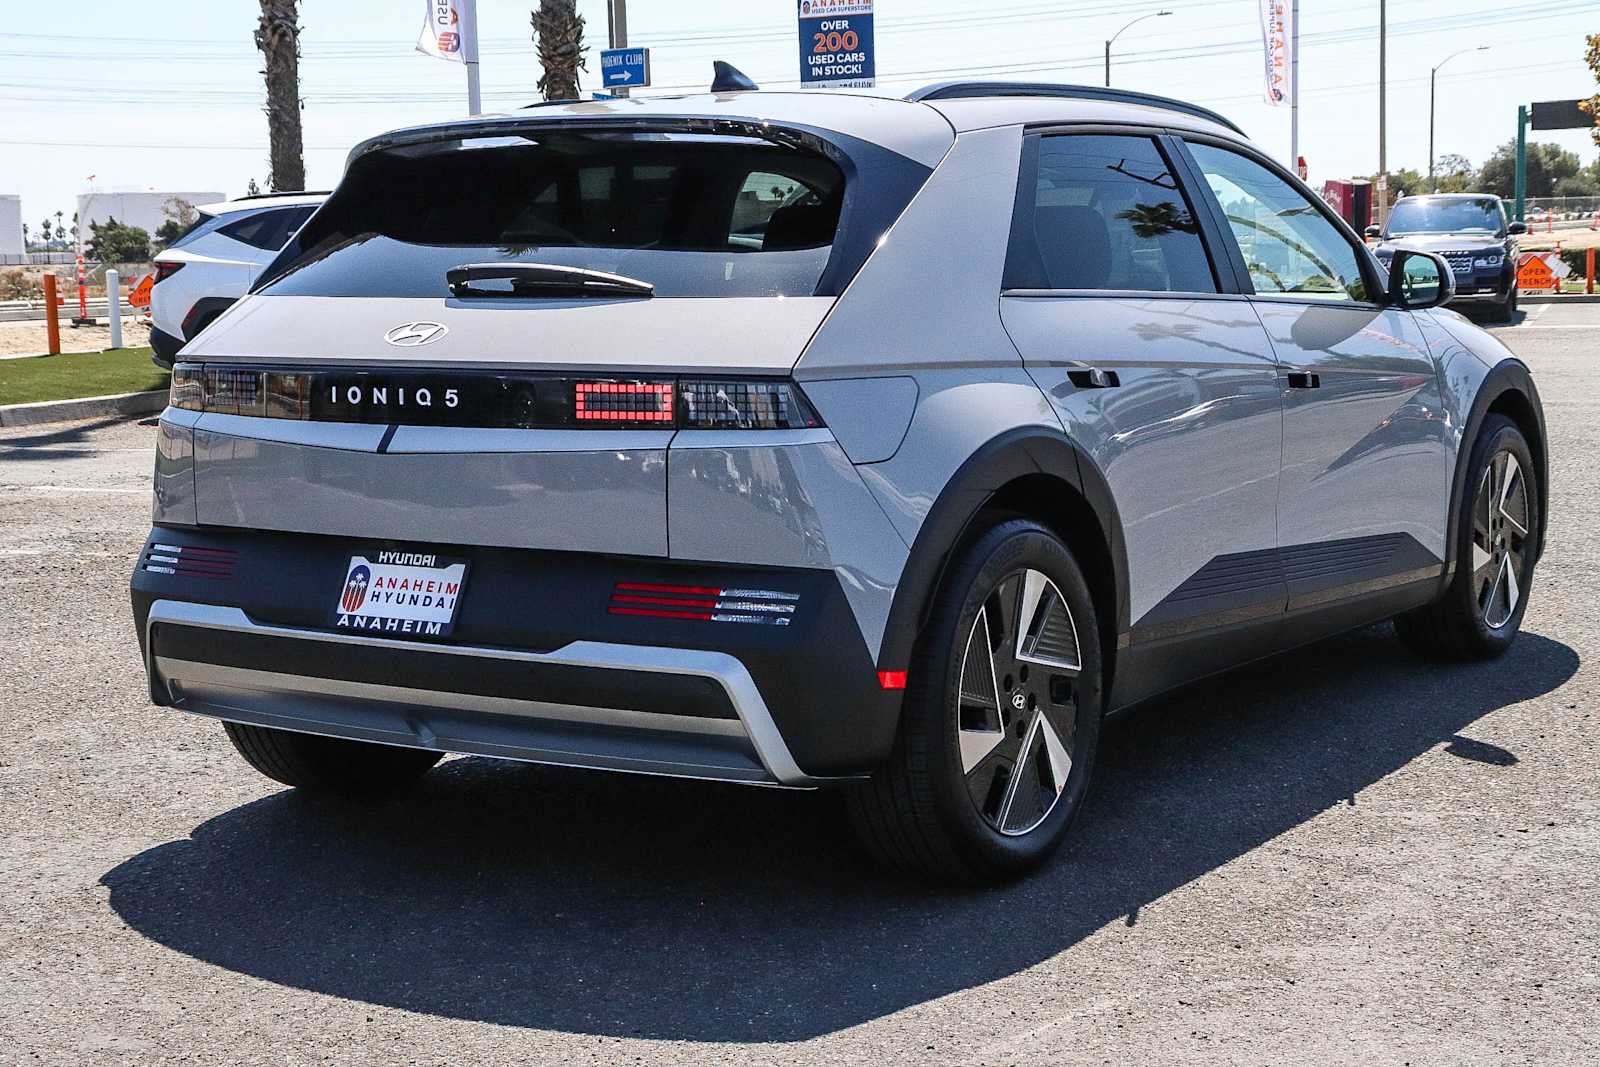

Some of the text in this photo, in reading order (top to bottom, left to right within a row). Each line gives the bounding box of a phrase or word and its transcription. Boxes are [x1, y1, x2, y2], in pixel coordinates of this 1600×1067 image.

[820, 20, 849, 31] OVER
[814, 31, 859, 53] 200
[625, 53, 643, 65] CLUB
[808, 52, 866, 65] USED CARS
[812, 65, 862, 76] IN STOCK!
[1523, 268, 1546, 276] OPEN
[331, 386, 459, 408] IONIQ 5
[378, 551, 436, 567] HYUNDAI
[374, 577, 459, 595] ANAHEIM
[370, 591, 455, 610] HYUNDAI
[337, 614, 442, 635] ANAHEIM
